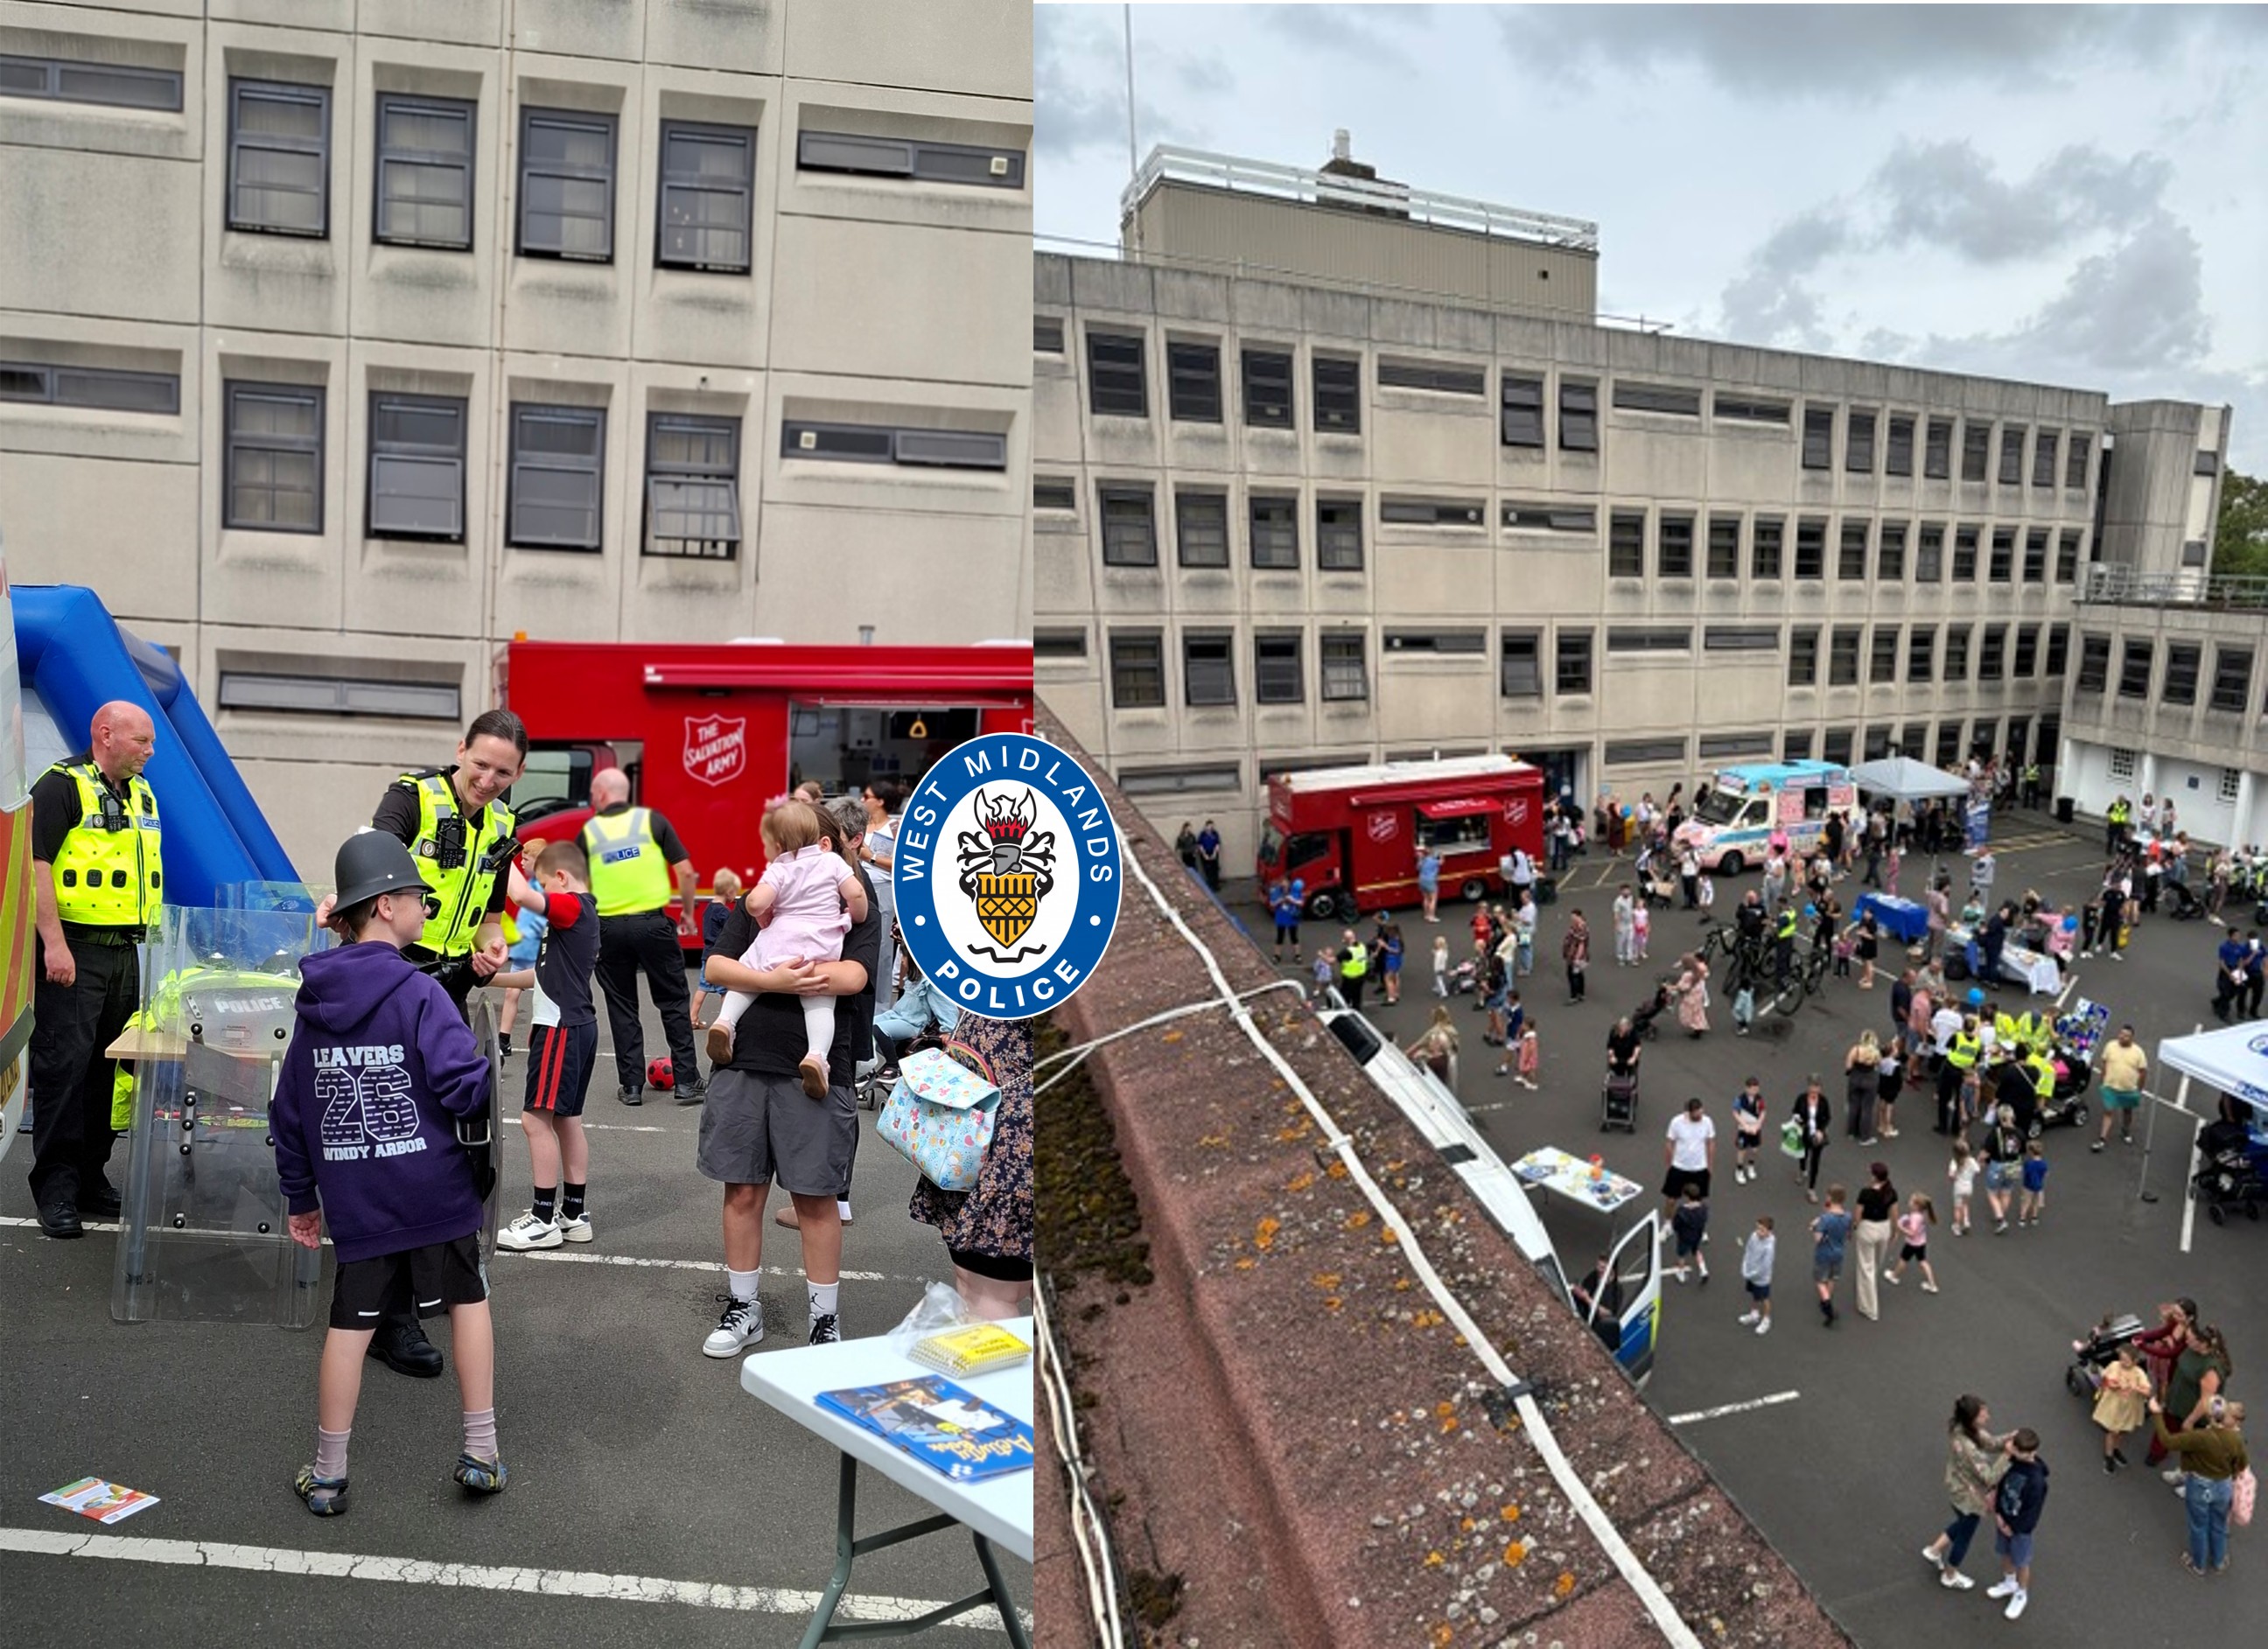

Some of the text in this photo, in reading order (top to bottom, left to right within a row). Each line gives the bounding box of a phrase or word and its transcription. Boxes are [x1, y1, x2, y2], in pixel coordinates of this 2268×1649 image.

[697, 722, 718, 743] THE
[685, 727, 743, 768] SALVATION
[705, 748, 738, 778] ARMY
[214, 997, 284, 1013] POLICE
[312, 1045, 404, 1067] LEAVERS
[315, 1065, 420, 1144] 26
[323, 1136, 427, 1160] WINDY ARBOR
